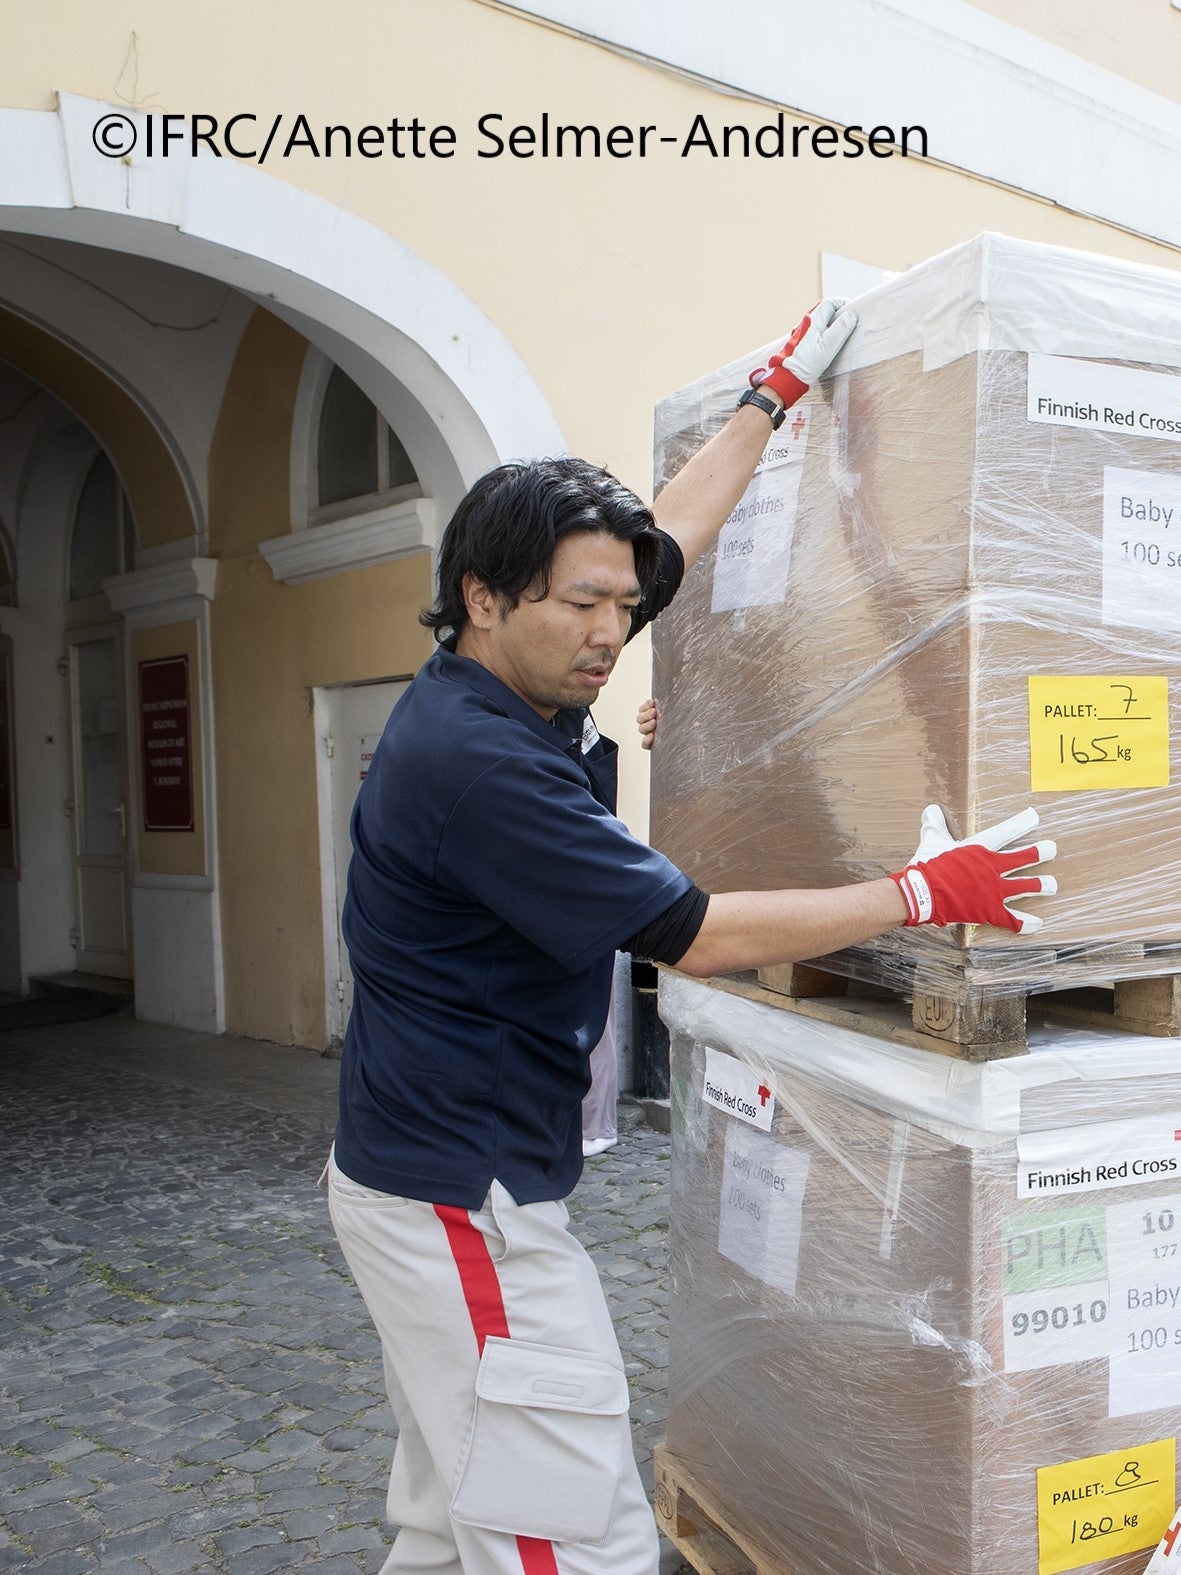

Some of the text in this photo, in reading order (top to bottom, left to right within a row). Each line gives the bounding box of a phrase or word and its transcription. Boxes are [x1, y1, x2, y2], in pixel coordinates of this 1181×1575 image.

[1037, 397, 1099, 422] Finnish
[1103, 407, 1135, 427] Red
[768, 447, 788, 463] Cross
[748, 496, 784, 519] clothes
[1120, 496, 1173, 529] Baby
[722, 538, 754, 559] 100 sets
[1120, 541, 1160, 566] 100
[1044, 684, 1138, 720] PALLET: 7
[1058, 734, 1132, 765] 165 kg
[705, 1081, 723, 1105] Finnish
[723, 1092, 736, 1110] Red
[737, 1098, 757, 1118] Cross
[1027, 1157, 1178, 1190] Finnish Red Cross
[1141, 1208, 1175, 1235] 10
[1004, 1223, 1104, 1275] PHA
[1152, 1243, 1179, 1259] 177
[1126, 1285, 1181, 1310] Baby
[1011, 1300, 1107, 1336] 99010
[1126, 1327, 1167, 1354] 100
[1052, 1461, 1141, 1507] PALLET: 8
[1071, 1513, 1138, 1545] 180 kg
